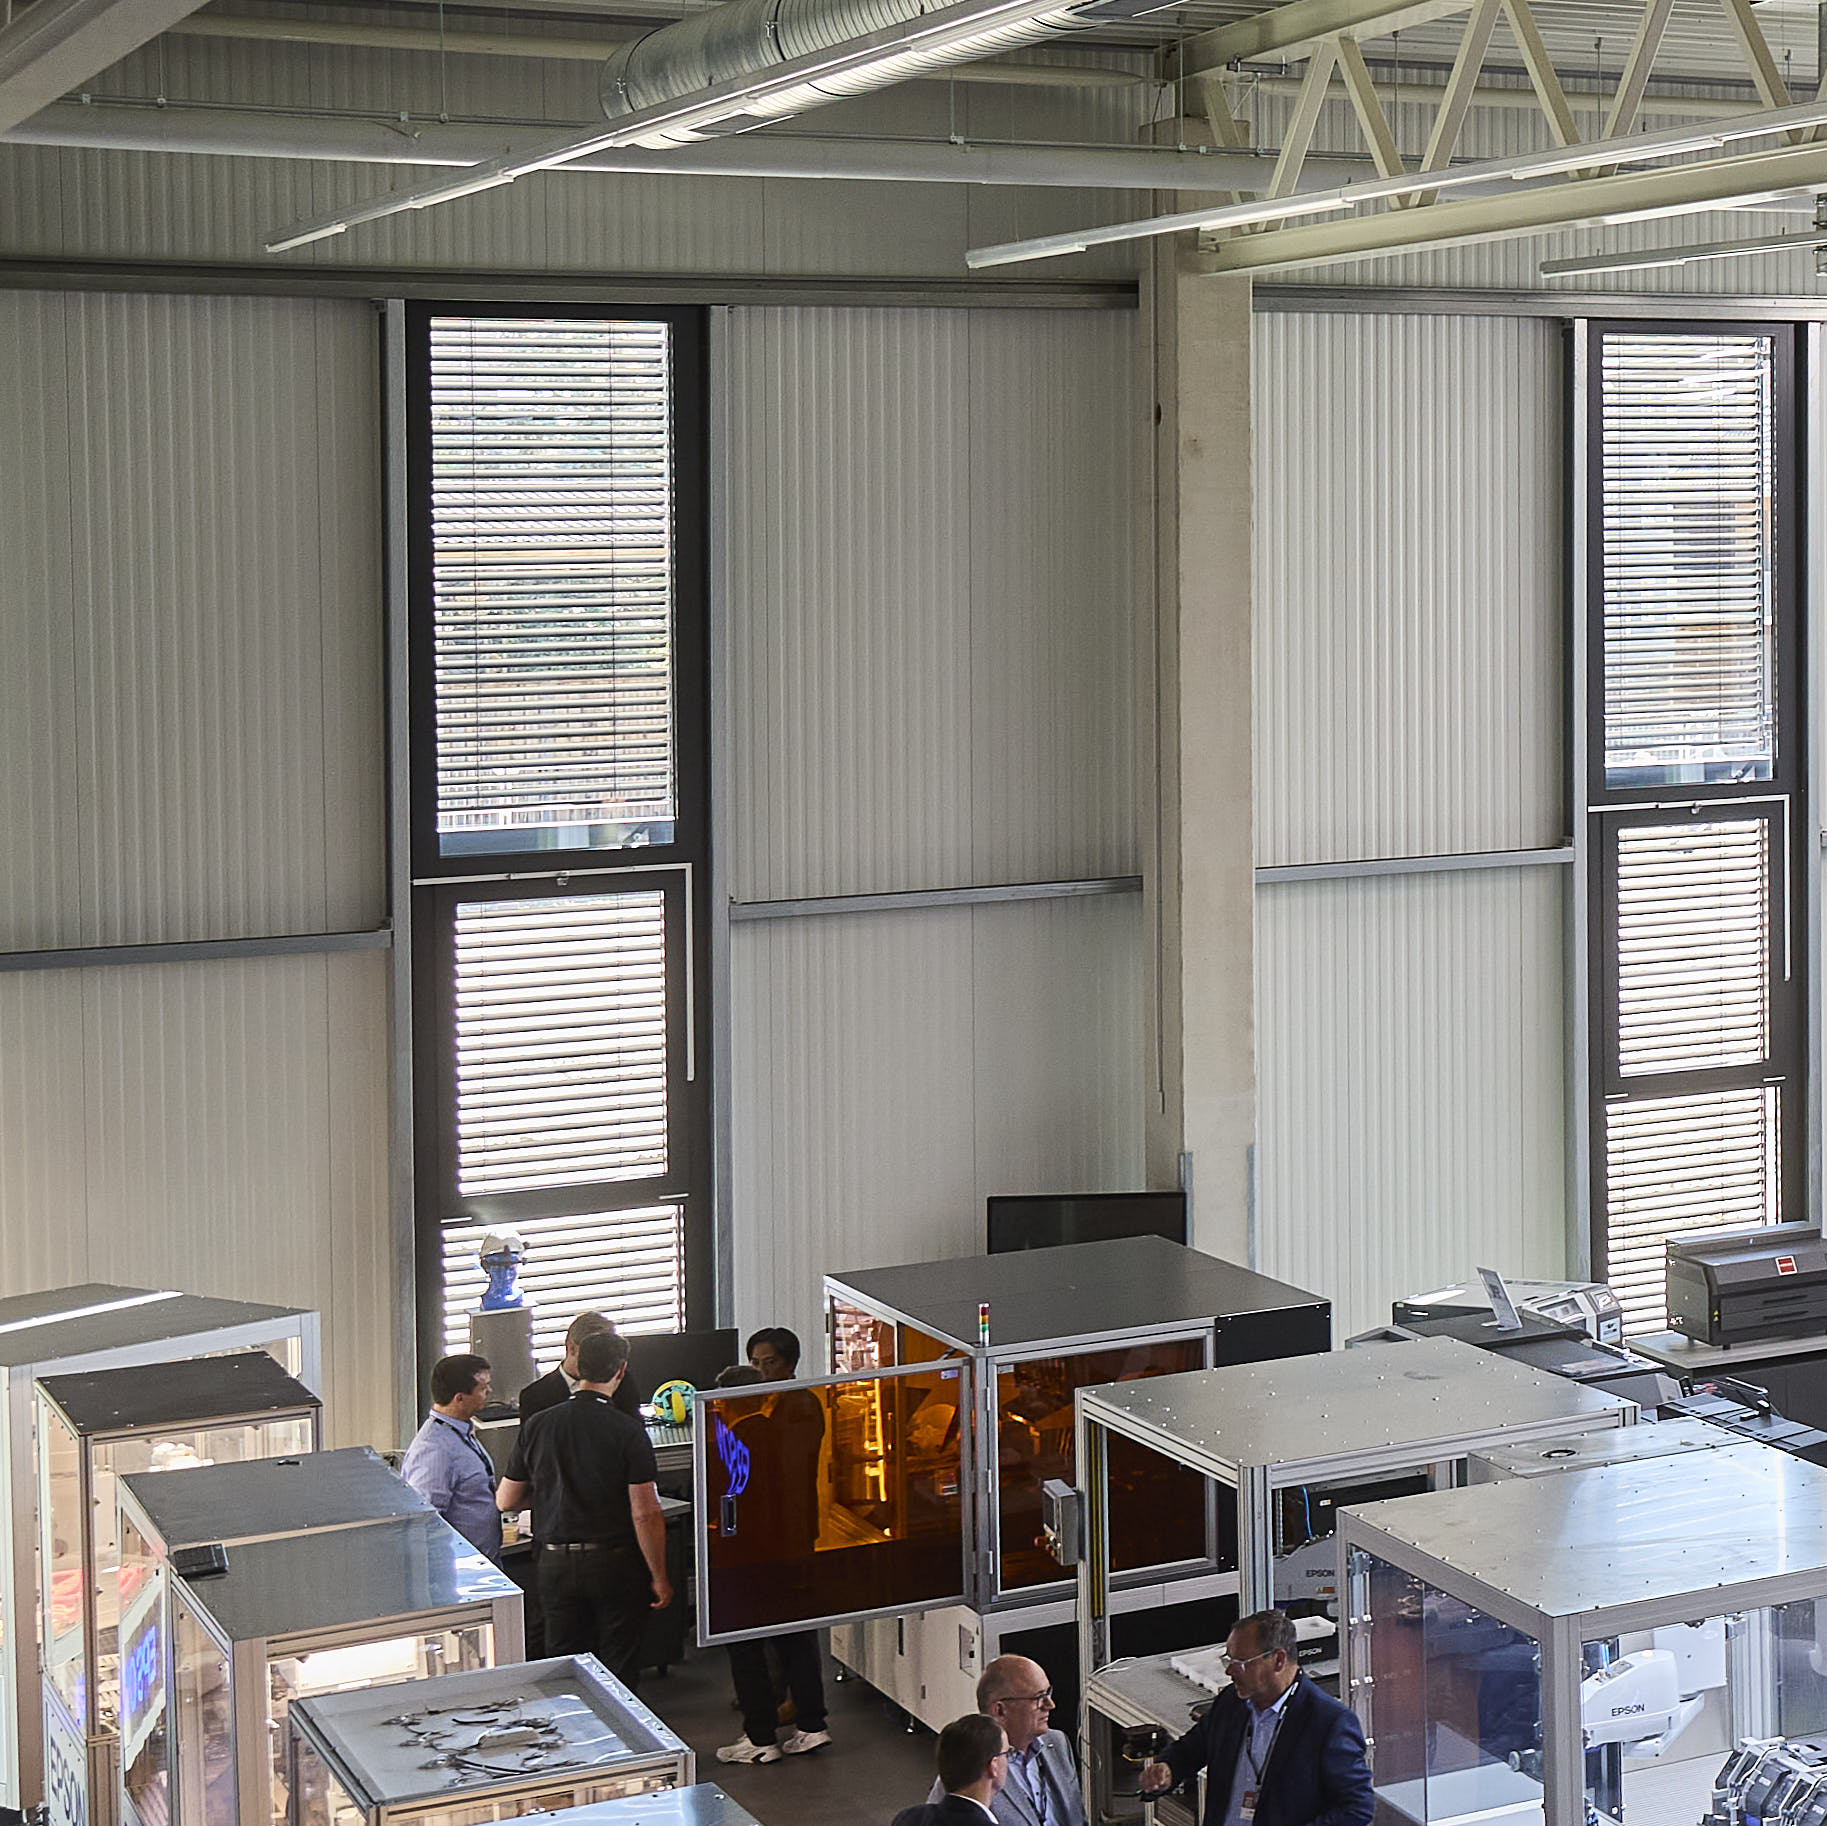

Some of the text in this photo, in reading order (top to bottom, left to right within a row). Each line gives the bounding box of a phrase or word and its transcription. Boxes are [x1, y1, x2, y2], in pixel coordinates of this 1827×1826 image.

[1305, 1569, 1335, 1578] EPSON
[1298, 1647, 1322, 1657] PSON
[1611, 1703, 1646, 1717] EPSON
